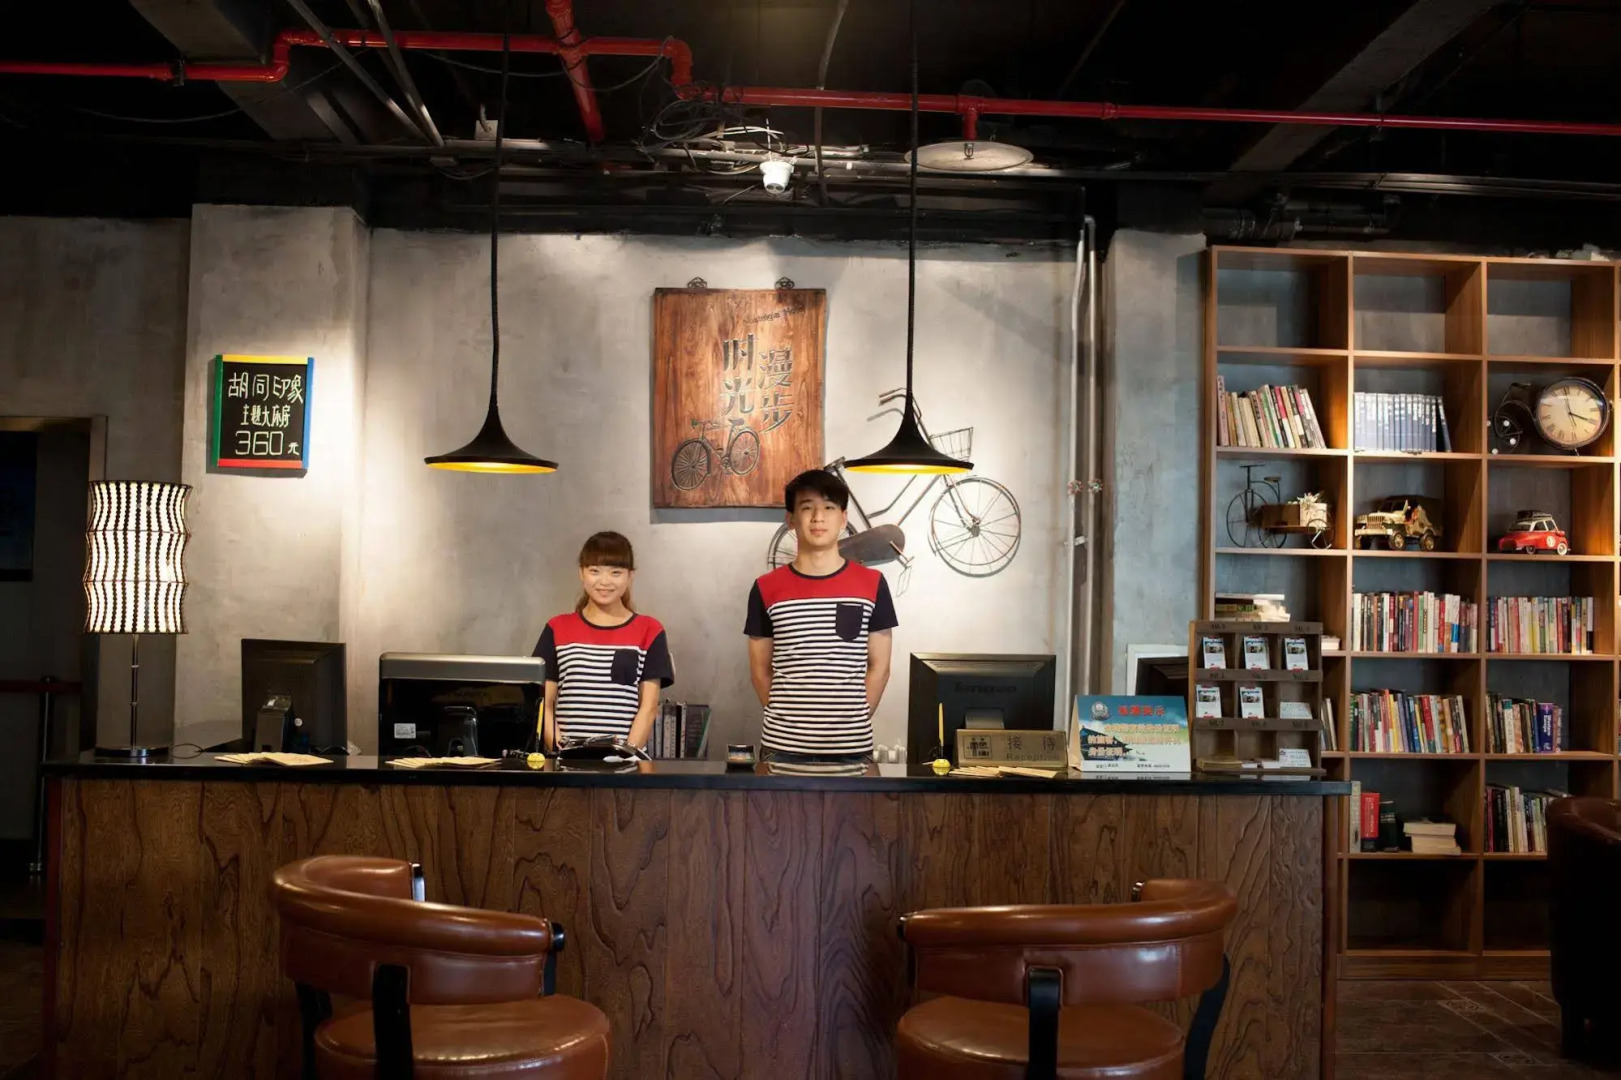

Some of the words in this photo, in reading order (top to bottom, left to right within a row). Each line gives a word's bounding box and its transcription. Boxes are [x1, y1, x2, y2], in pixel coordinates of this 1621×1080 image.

[742, 311, 780, 324] stalgia
[228, 372, 304, 404] 胡同印象
[758, 348, 795, 434] 漫步
[240, 404, 291, 427] 主题大床房
